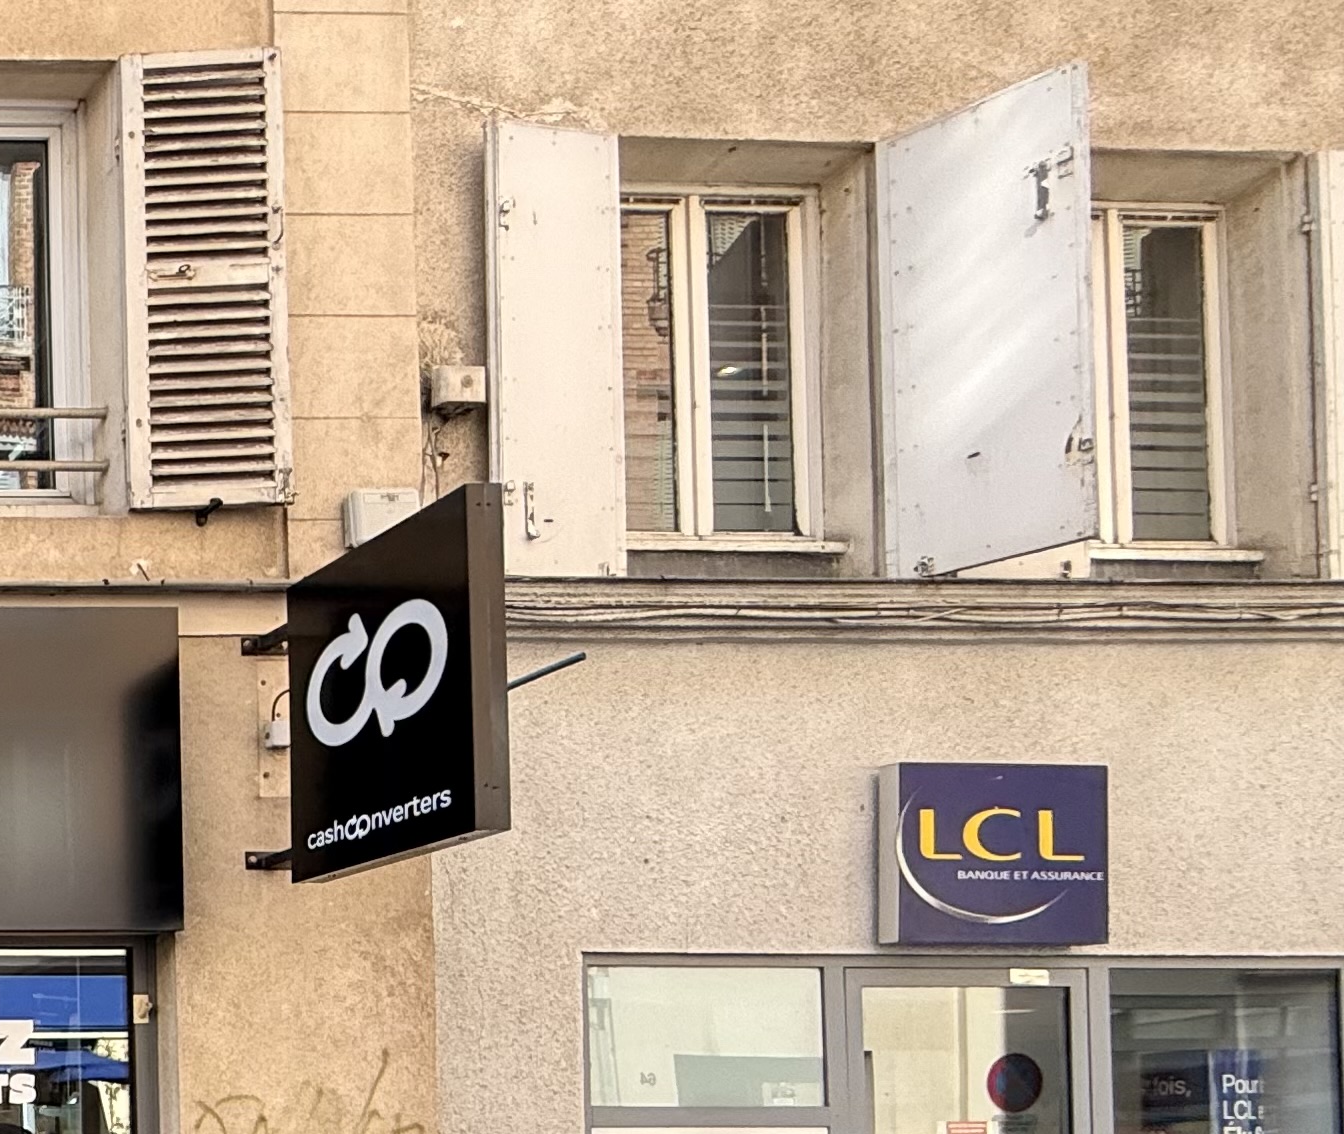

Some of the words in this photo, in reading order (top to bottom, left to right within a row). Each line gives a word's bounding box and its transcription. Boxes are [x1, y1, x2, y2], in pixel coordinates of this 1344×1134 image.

[919, 808, 1085, 861] LCL
[957, 870, 1010, 880] BANQUE
[1014, 871, 1029, 880] ET
[1031, 872, 1104, 881] ASSURANCE
[1223, 1100, 1257, 1120] LCL
